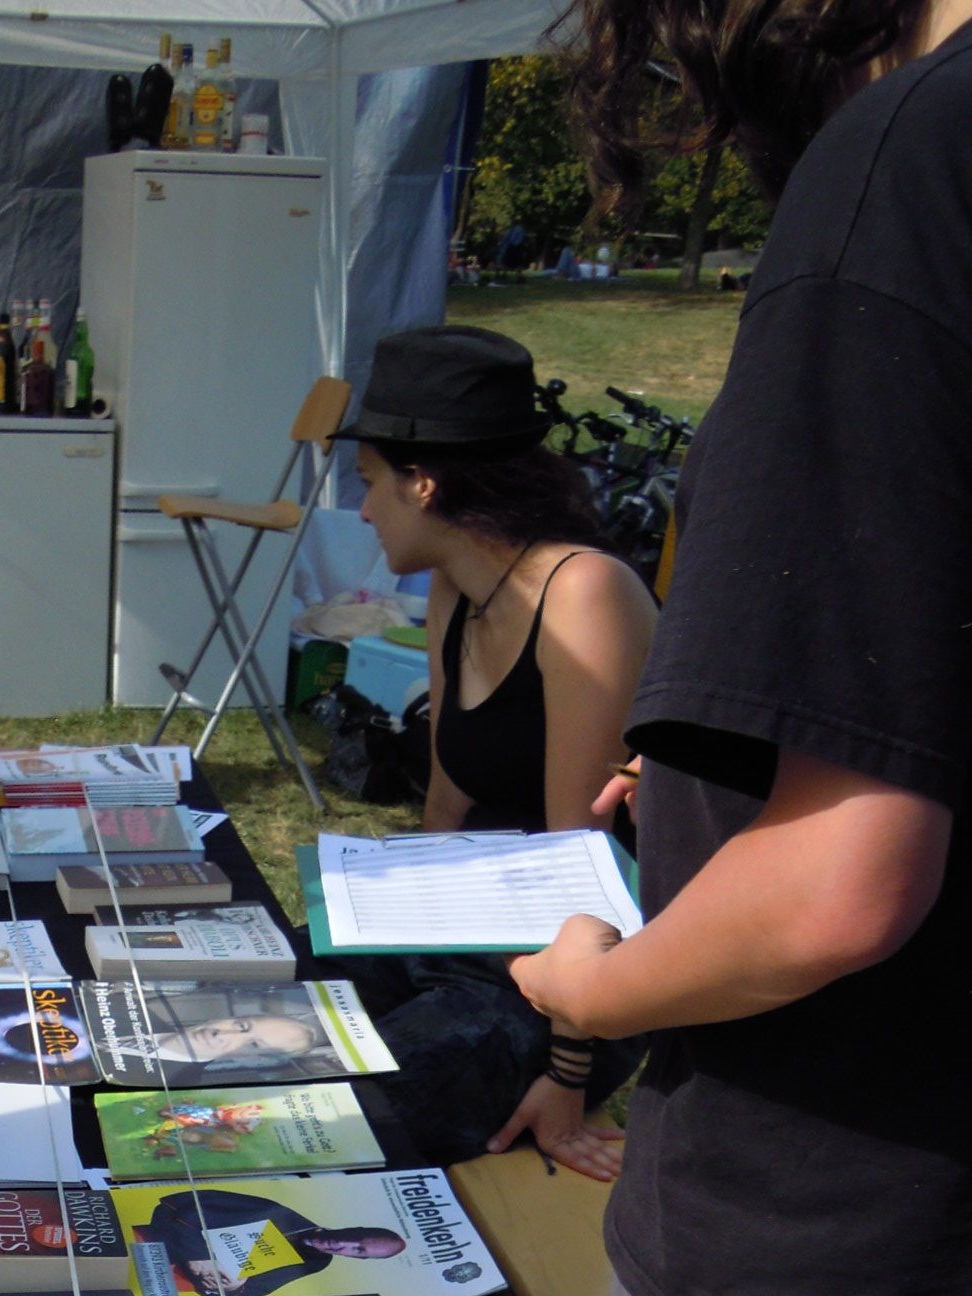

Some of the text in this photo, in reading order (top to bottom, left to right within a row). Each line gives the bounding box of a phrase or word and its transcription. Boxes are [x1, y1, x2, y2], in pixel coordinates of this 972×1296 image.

[95, 989, 111, 1017] Heinz
[24, 1209, 44, 1226] DER
[64, 1191, 103, 1253] DAWKINS
[89, 1196, 117, 1244] RICHARD
